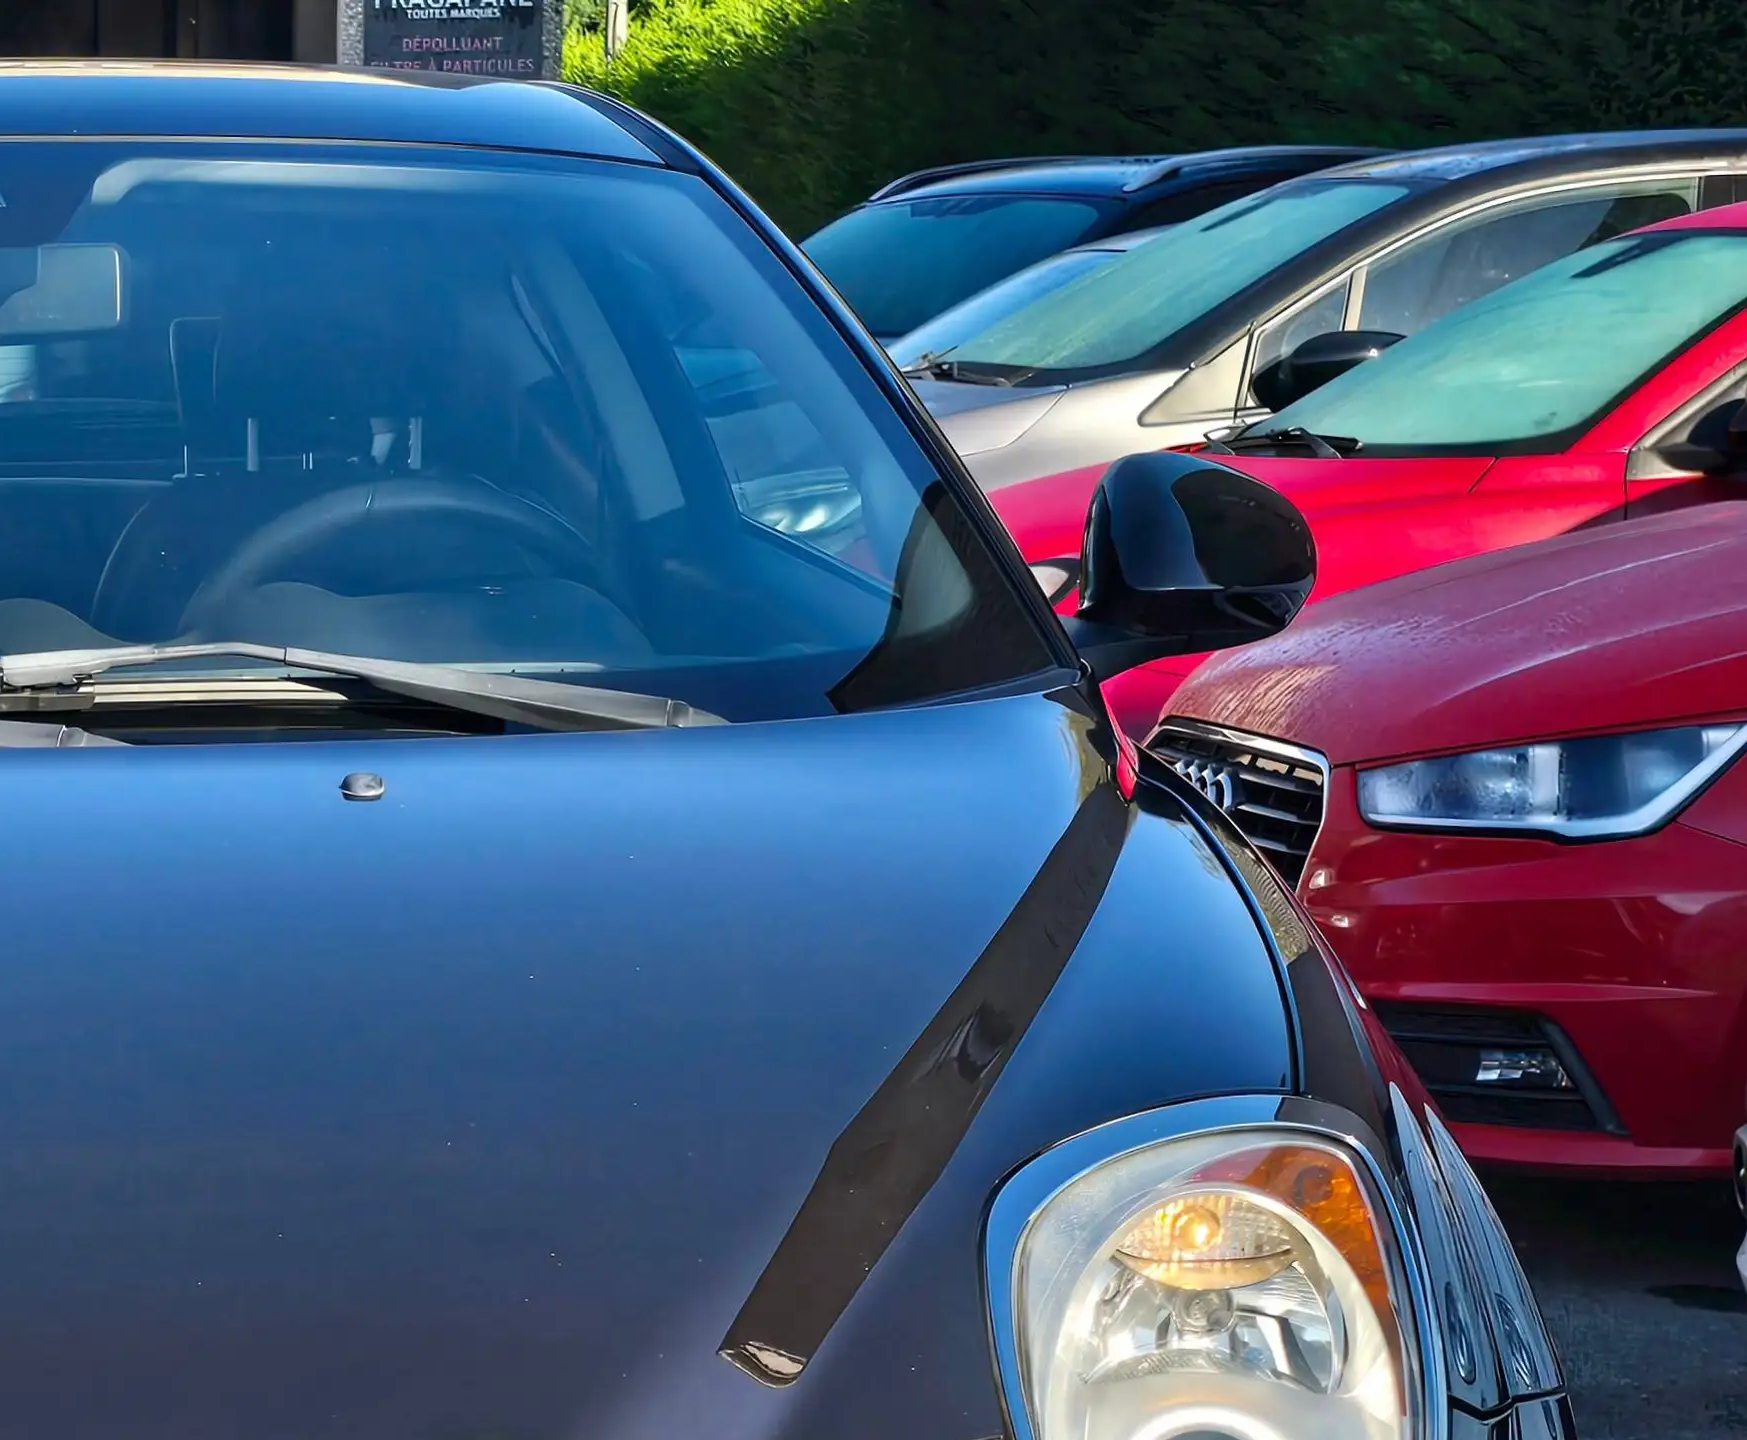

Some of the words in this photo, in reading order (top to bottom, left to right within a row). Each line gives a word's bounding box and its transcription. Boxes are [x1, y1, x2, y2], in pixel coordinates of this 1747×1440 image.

[406, 8, 447, 19] TOUTES
[450, 7, 501, 19] MARQUES
[403, 36, 503, 51] DÉPOLLUANT
[443, 58, 535, 73] PARTICULES
